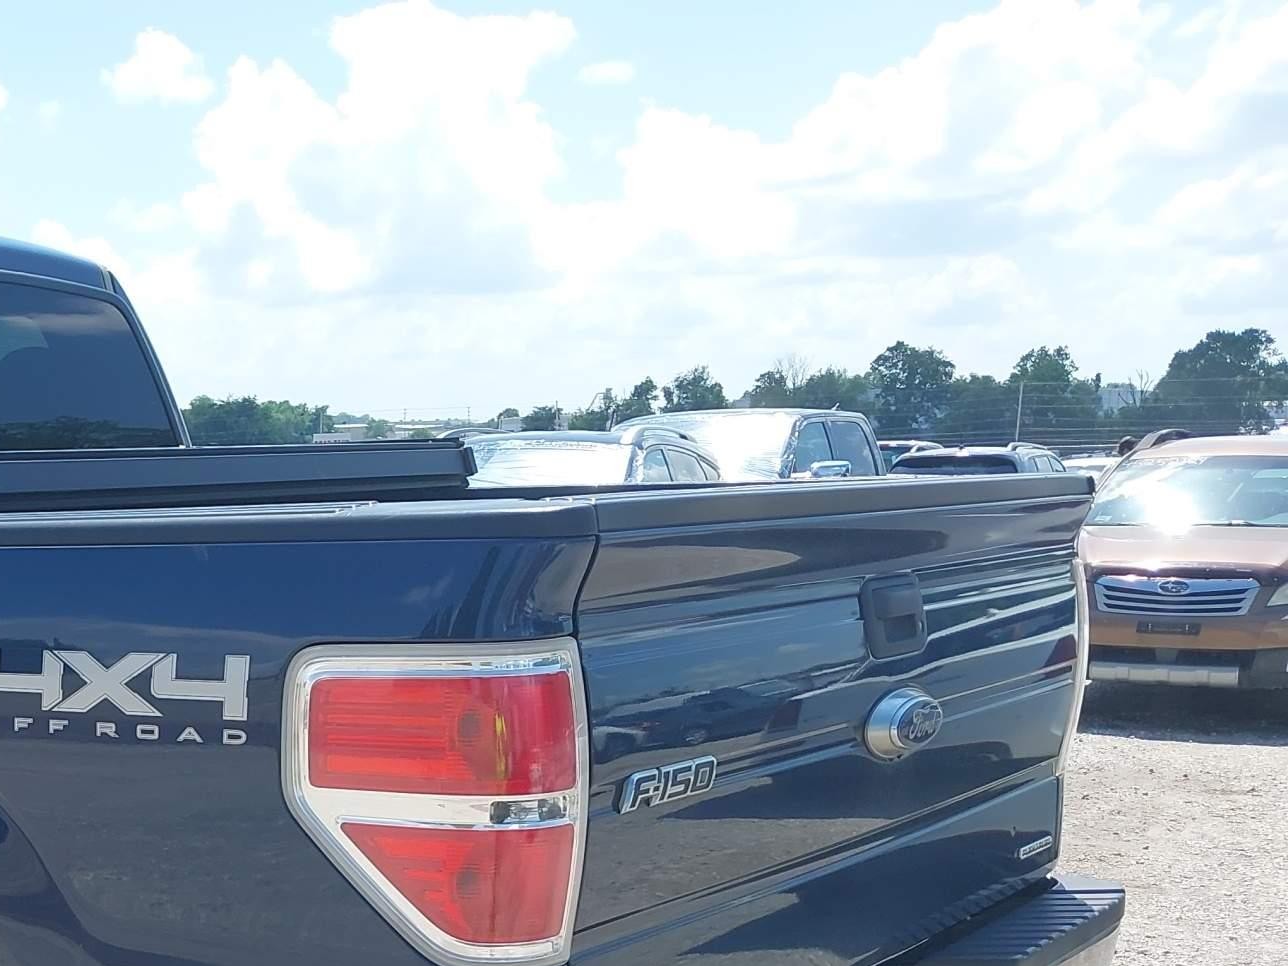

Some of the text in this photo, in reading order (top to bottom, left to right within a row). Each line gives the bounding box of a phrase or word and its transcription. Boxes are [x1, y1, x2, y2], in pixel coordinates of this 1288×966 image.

[95, 721, 248, 745] ROAD
[909, 704, 941, 740] Ford
[619, 755, 717, 815] F-150
